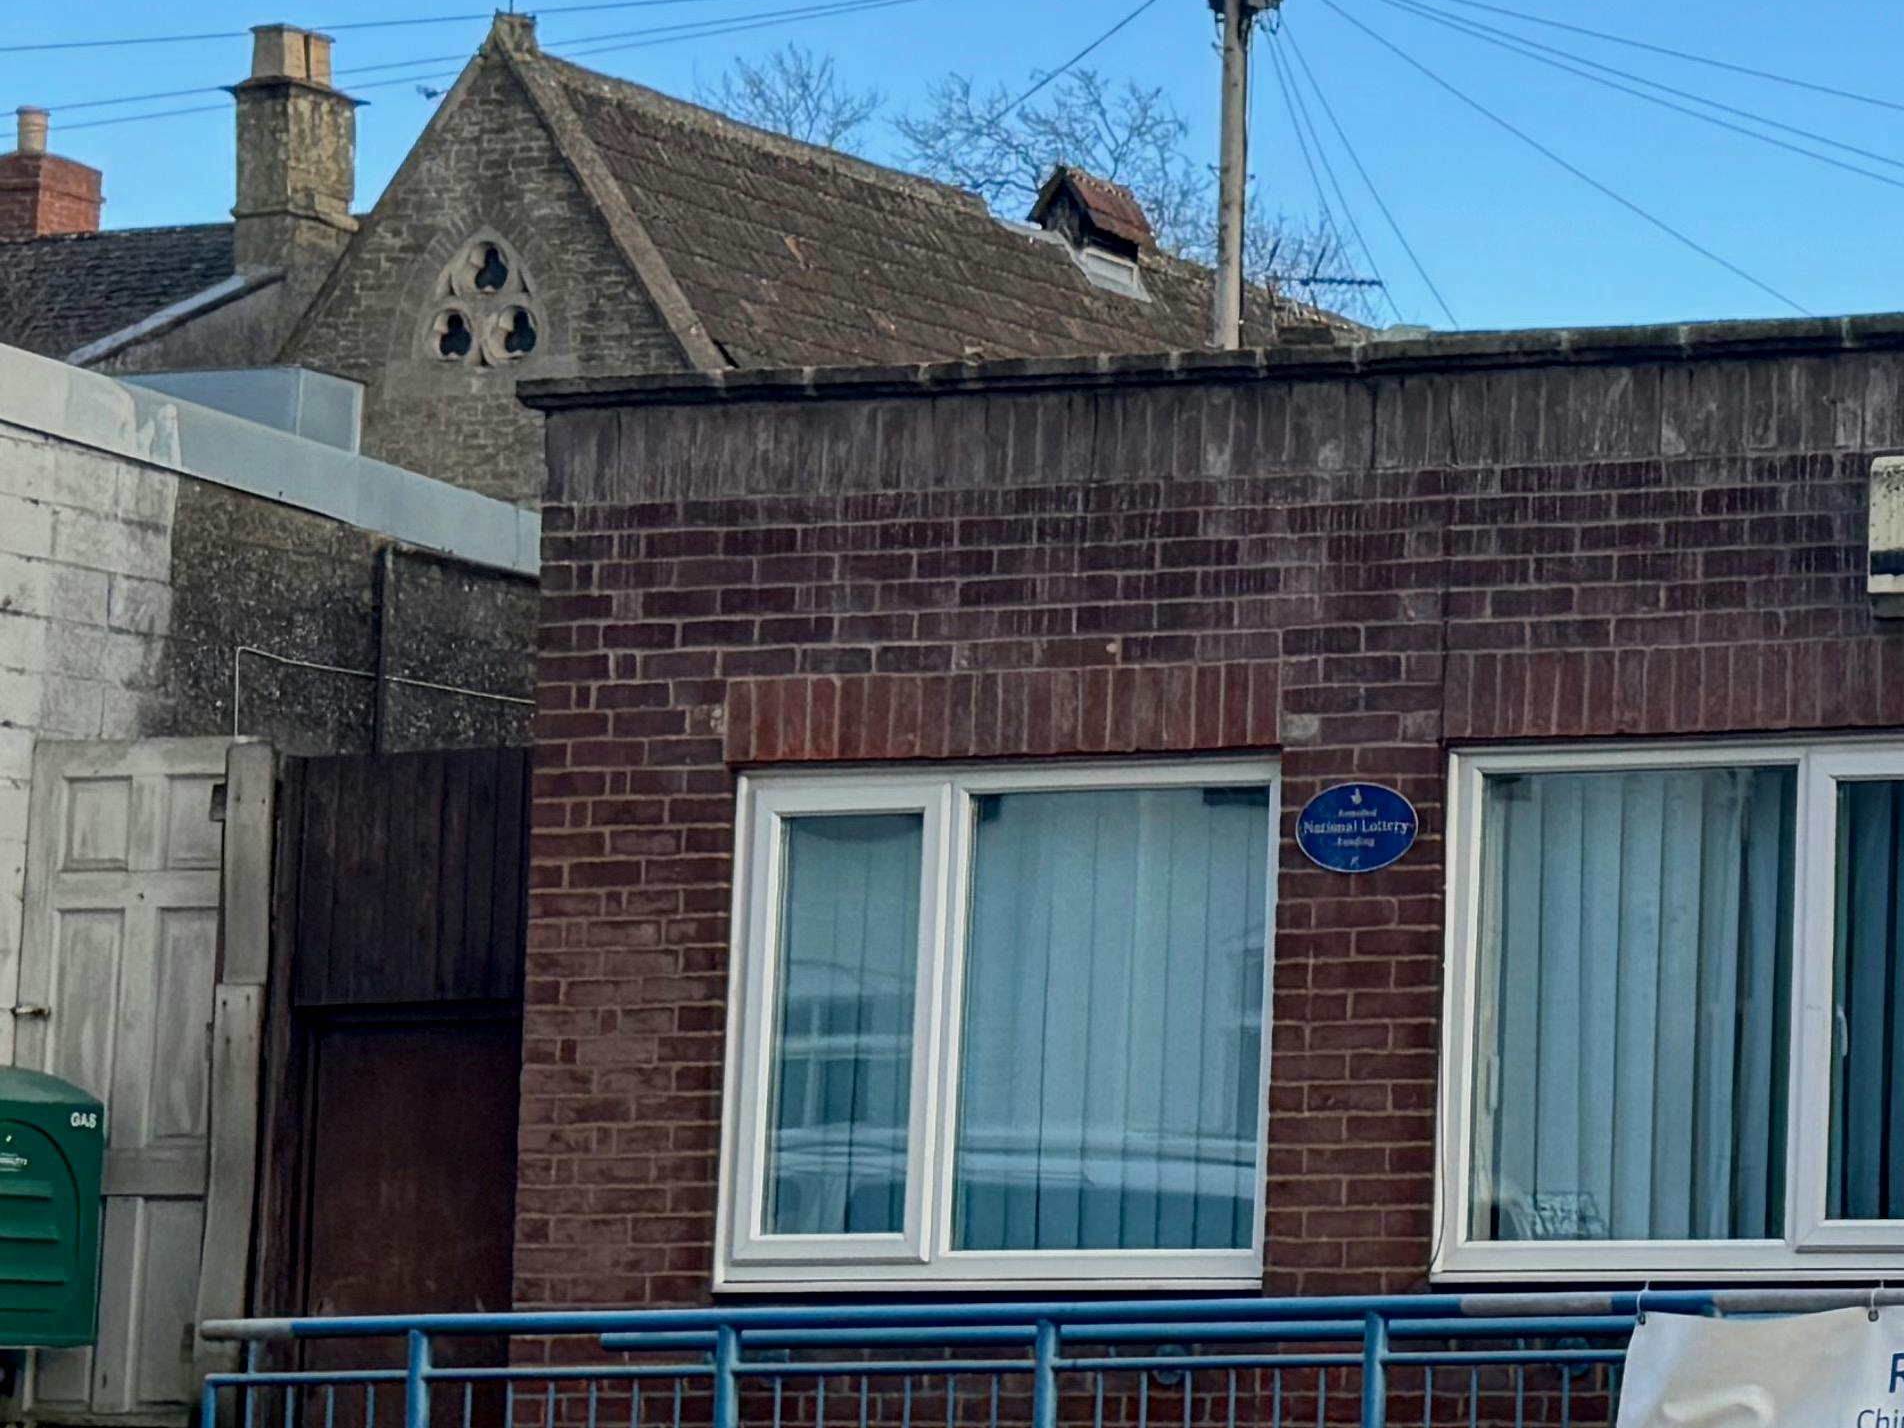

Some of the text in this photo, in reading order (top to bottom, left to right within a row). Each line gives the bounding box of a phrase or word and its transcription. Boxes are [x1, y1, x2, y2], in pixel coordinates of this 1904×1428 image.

[1303, 819, 1409, 835] National Lottery
[70, 1112, 97, 1129] GAS
